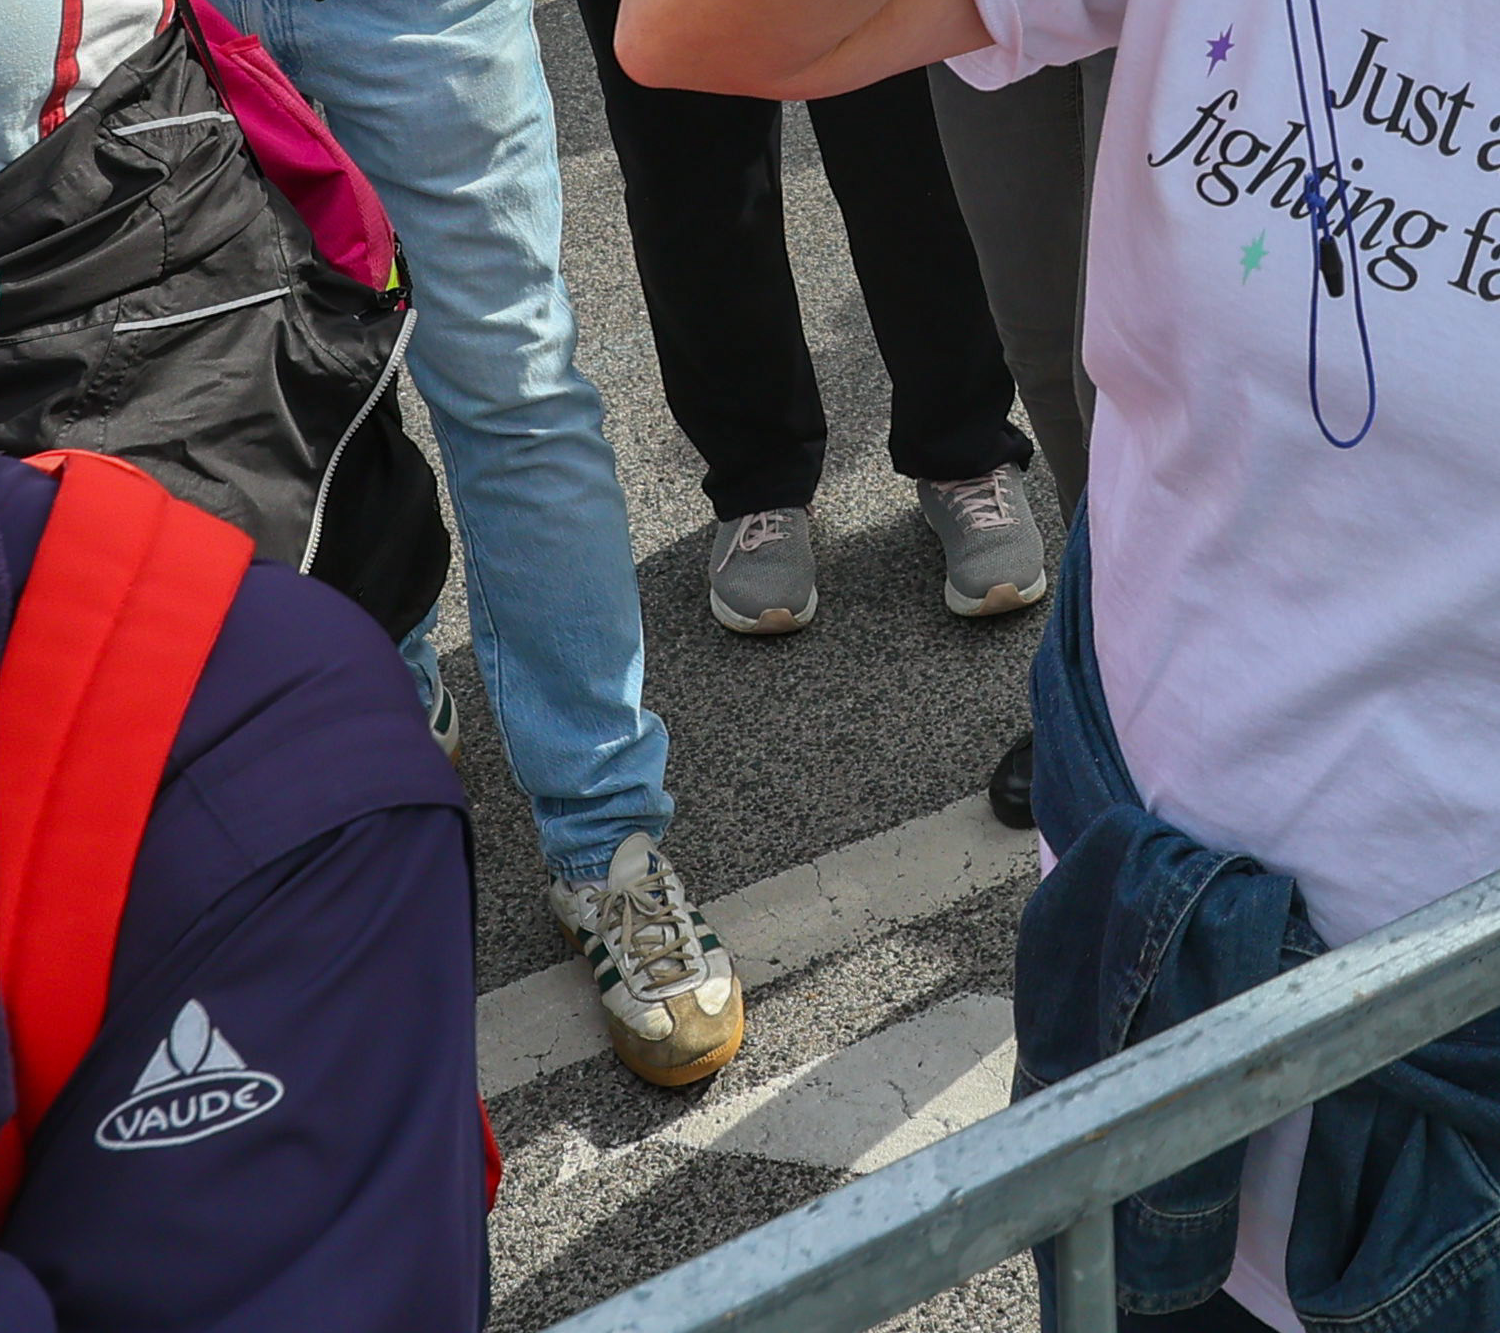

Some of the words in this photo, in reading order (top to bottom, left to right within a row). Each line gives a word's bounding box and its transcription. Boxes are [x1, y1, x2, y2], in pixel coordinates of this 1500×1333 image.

[1327, 28, 1475, 156] Just
[1148, 89, 1449, 292] fighting
[115, 1081, 260, 1141] VAUDE
